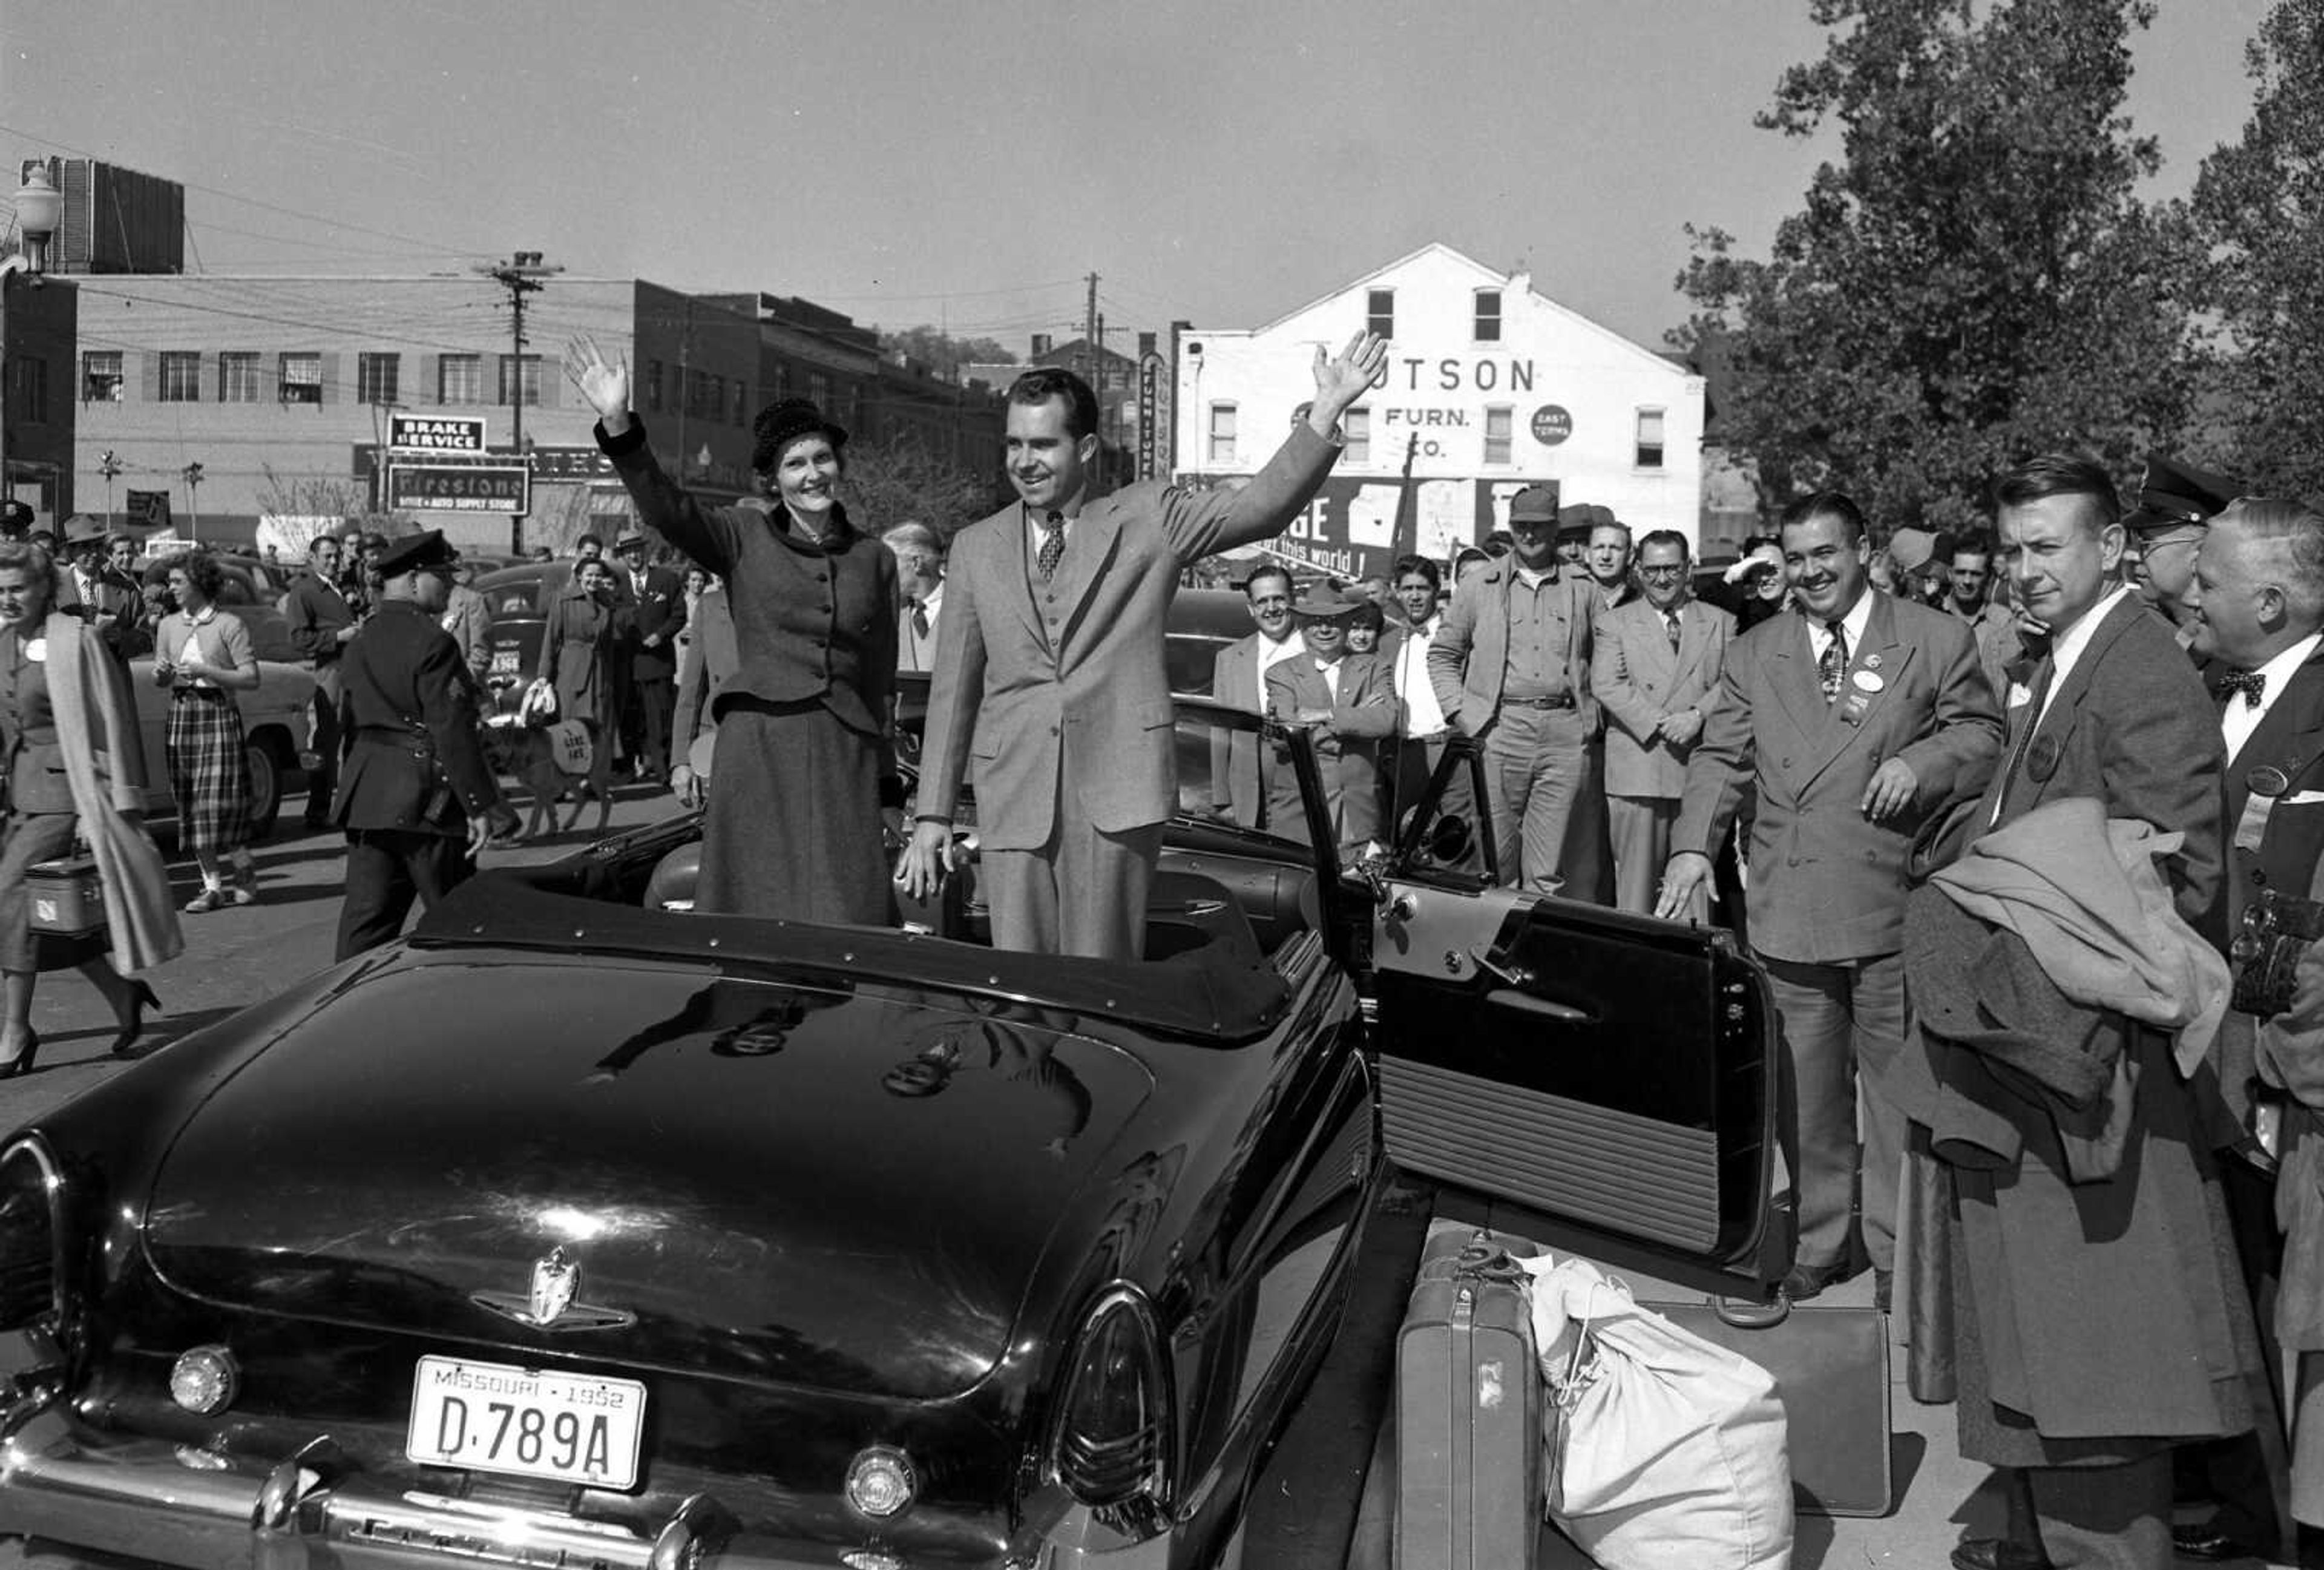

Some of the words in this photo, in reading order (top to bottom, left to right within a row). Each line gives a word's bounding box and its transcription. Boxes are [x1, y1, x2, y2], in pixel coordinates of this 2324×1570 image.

[1369, 355, 1533, 392] UTSON
[404, 421, 470, 435] BRAKE
[1386, 408, 1469, 427] FURN.
[397, 433, 476, 448] SERVICE
[395, 470, 522, 496] Firestone
[1311, 548, 1351, 573] world
[435, 1370, 539, 1396] MISSOURI
[566, 1387, 624, 1409] 1952
